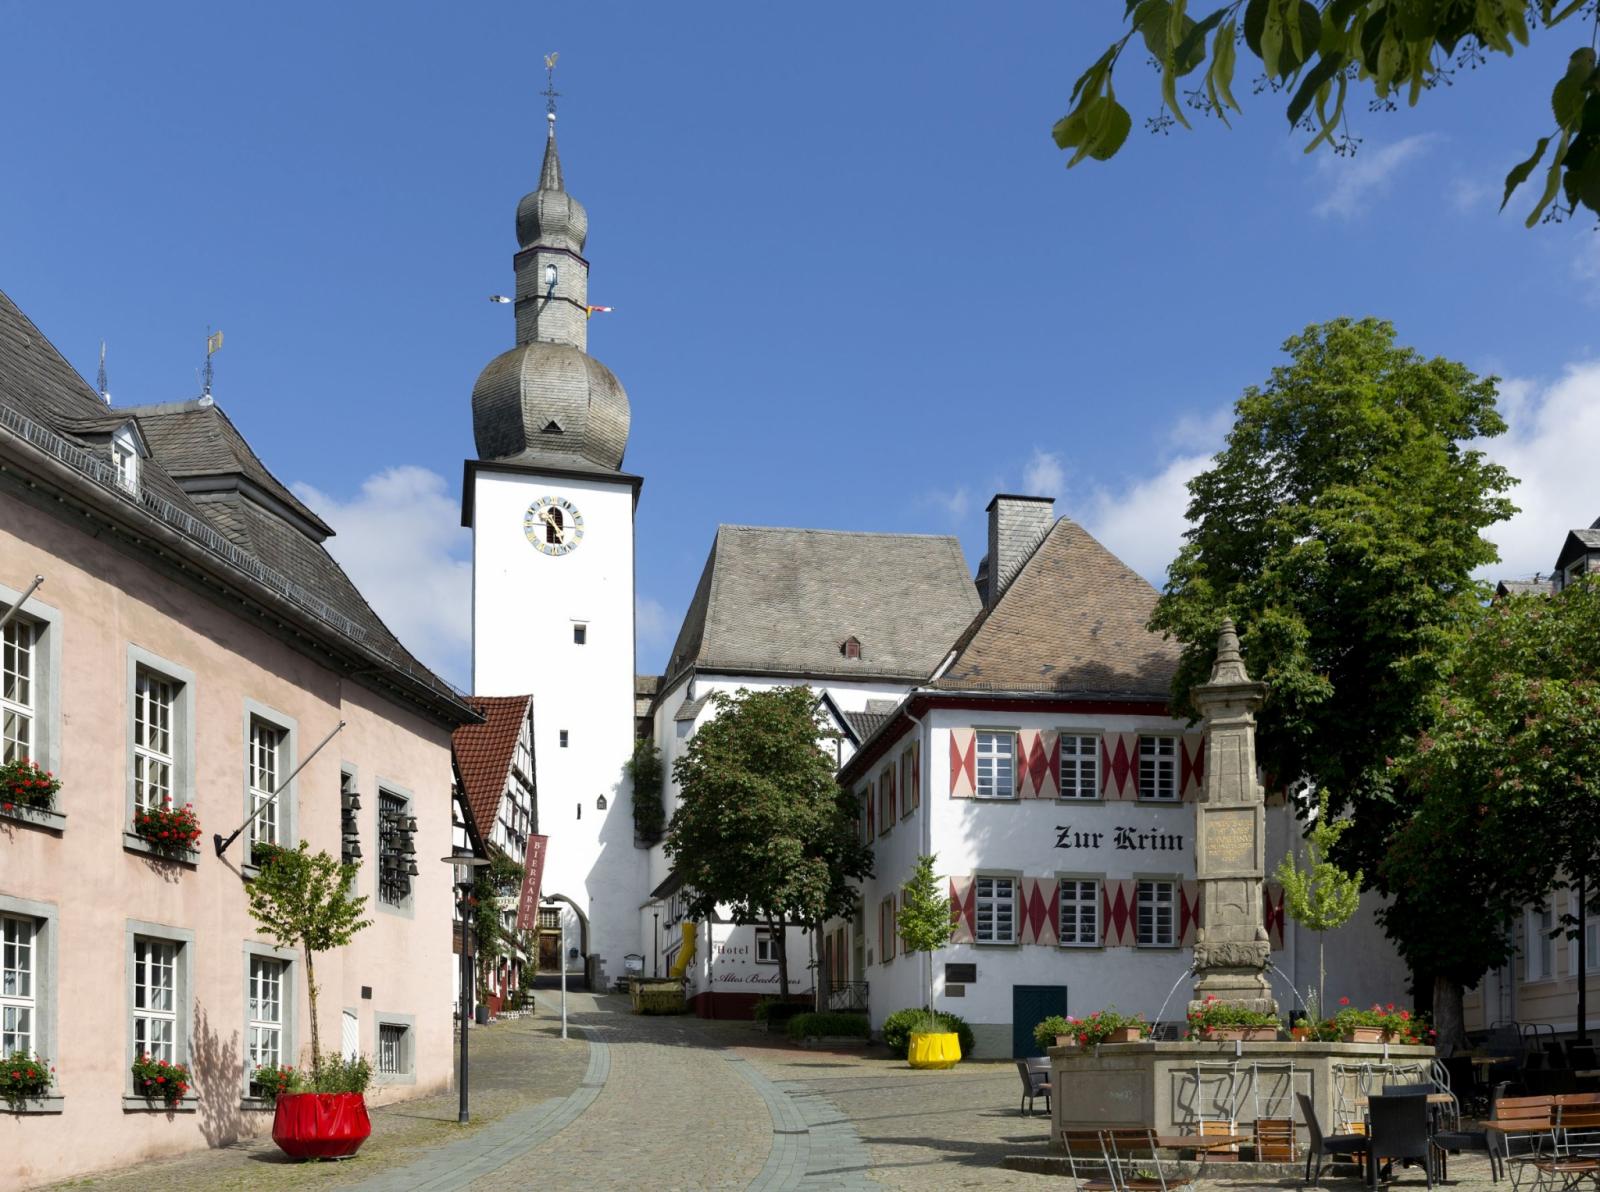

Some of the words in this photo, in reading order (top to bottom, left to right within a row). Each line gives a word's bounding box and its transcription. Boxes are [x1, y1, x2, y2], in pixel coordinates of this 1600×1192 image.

[1054, 825, 1104, 849] Zur
[1114, 826, 1184, 851] Krim
[522, 842, 541, 929] BIERGARTEN
[717, 944, 749, 954] Hotel
[715, 972, 743, 983] Altes
[745, 972, 801, 985] Backhus
